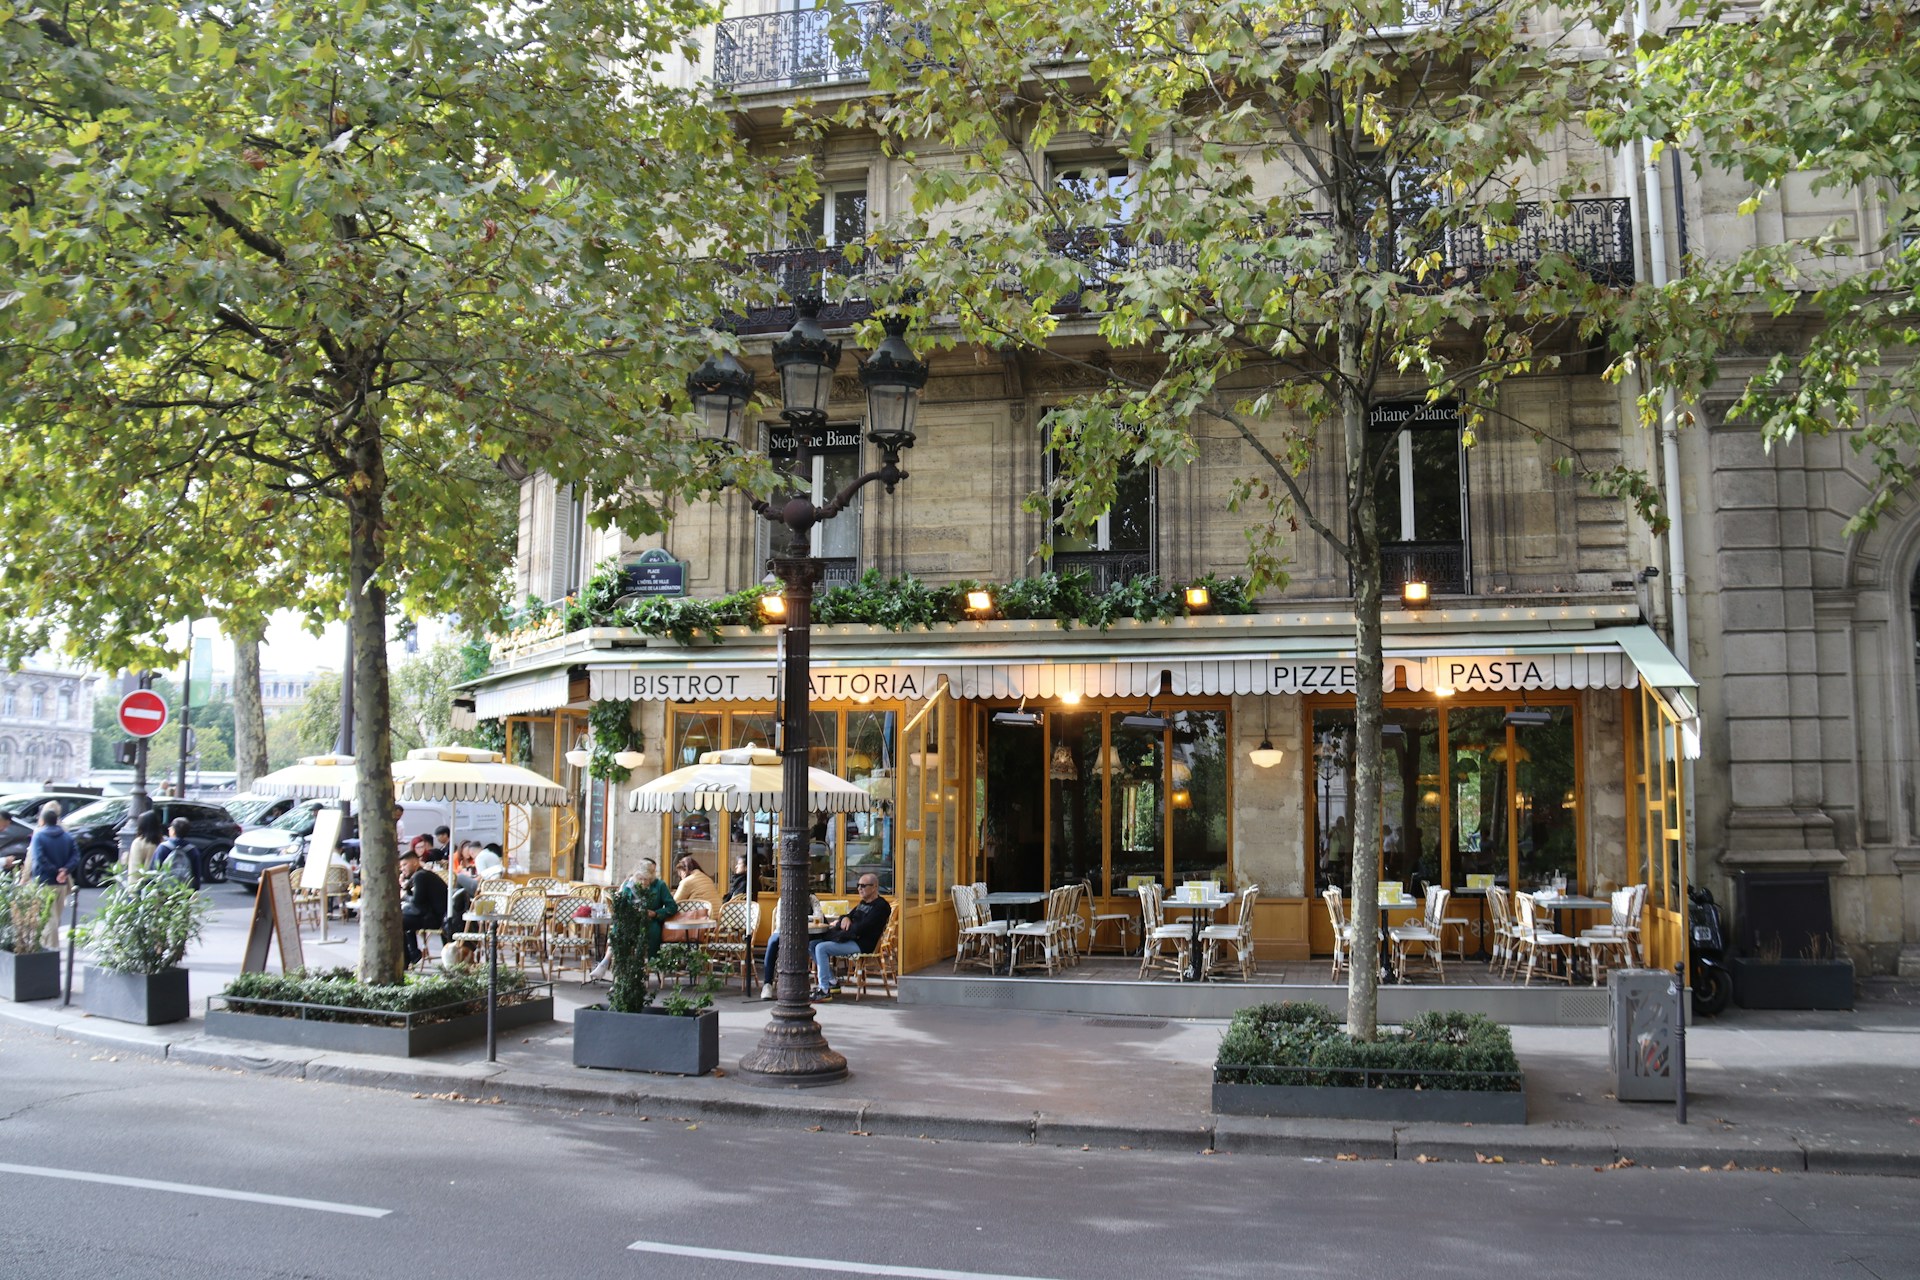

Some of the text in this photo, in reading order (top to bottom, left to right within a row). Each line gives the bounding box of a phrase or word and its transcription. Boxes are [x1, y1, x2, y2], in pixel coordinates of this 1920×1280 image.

[1370, 406, 1410, 426] phane
[770, 433, 823, 452] Stépne
[1450, 662, 1543, 684] PASTA
[634, 673, 917, 695] BISTROT TATTORIA
